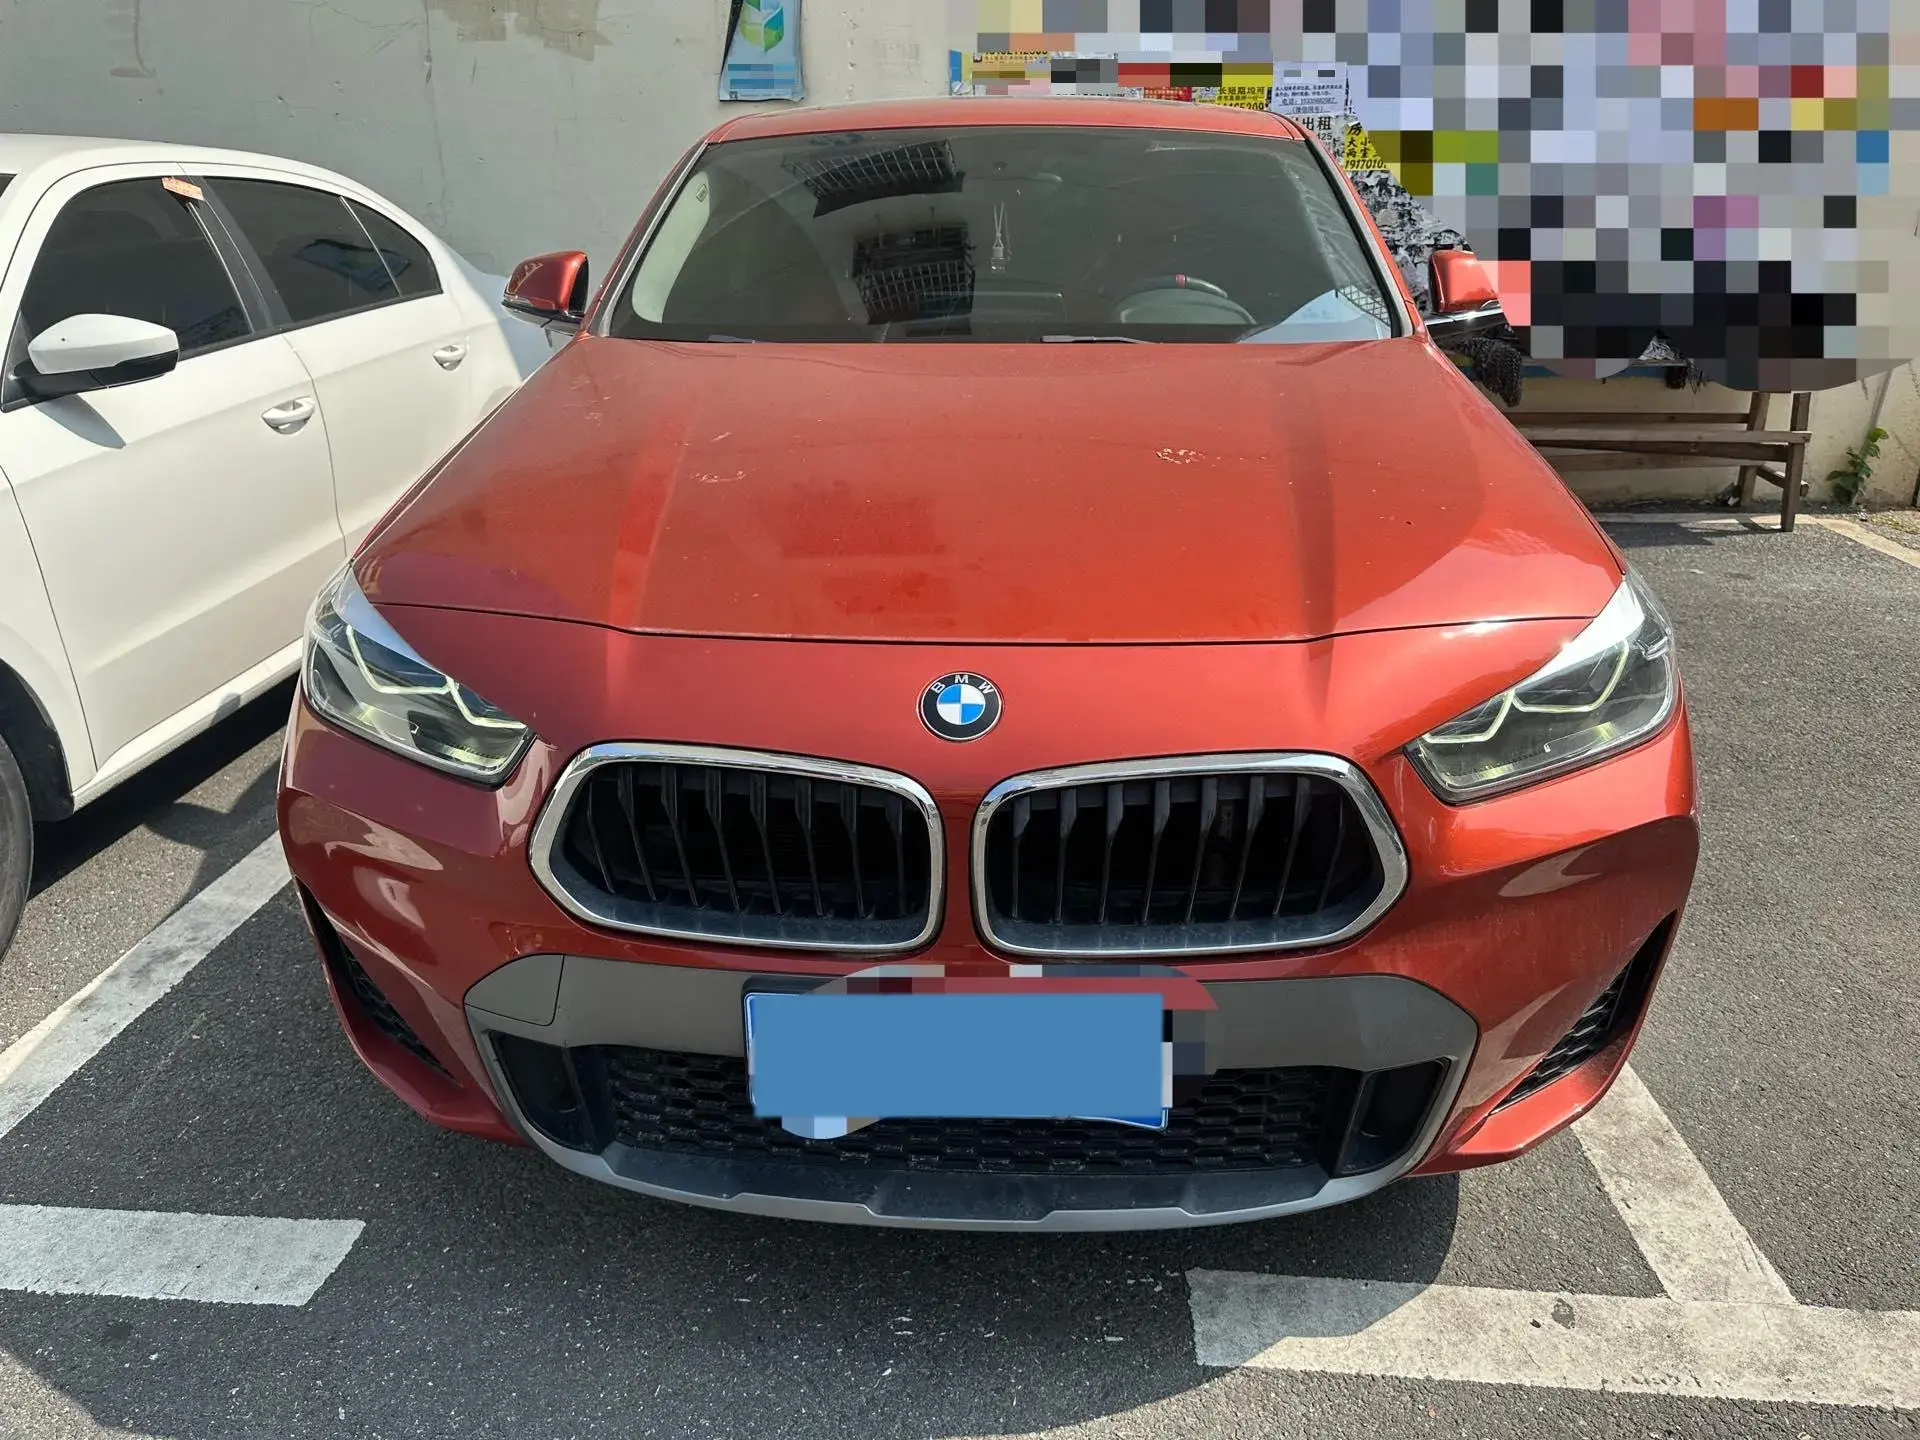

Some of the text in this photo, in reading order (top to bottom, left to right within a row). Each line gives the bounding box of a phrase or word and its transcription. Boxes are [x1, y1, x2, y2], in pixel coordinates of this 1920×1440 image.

[1218, 86, 1265, 95] 长短期均可
[1296, 115, 1332, 130] 出租
[1345, 159, 1386, 169] 1917010
[931, 674, 994, 694] BMW
